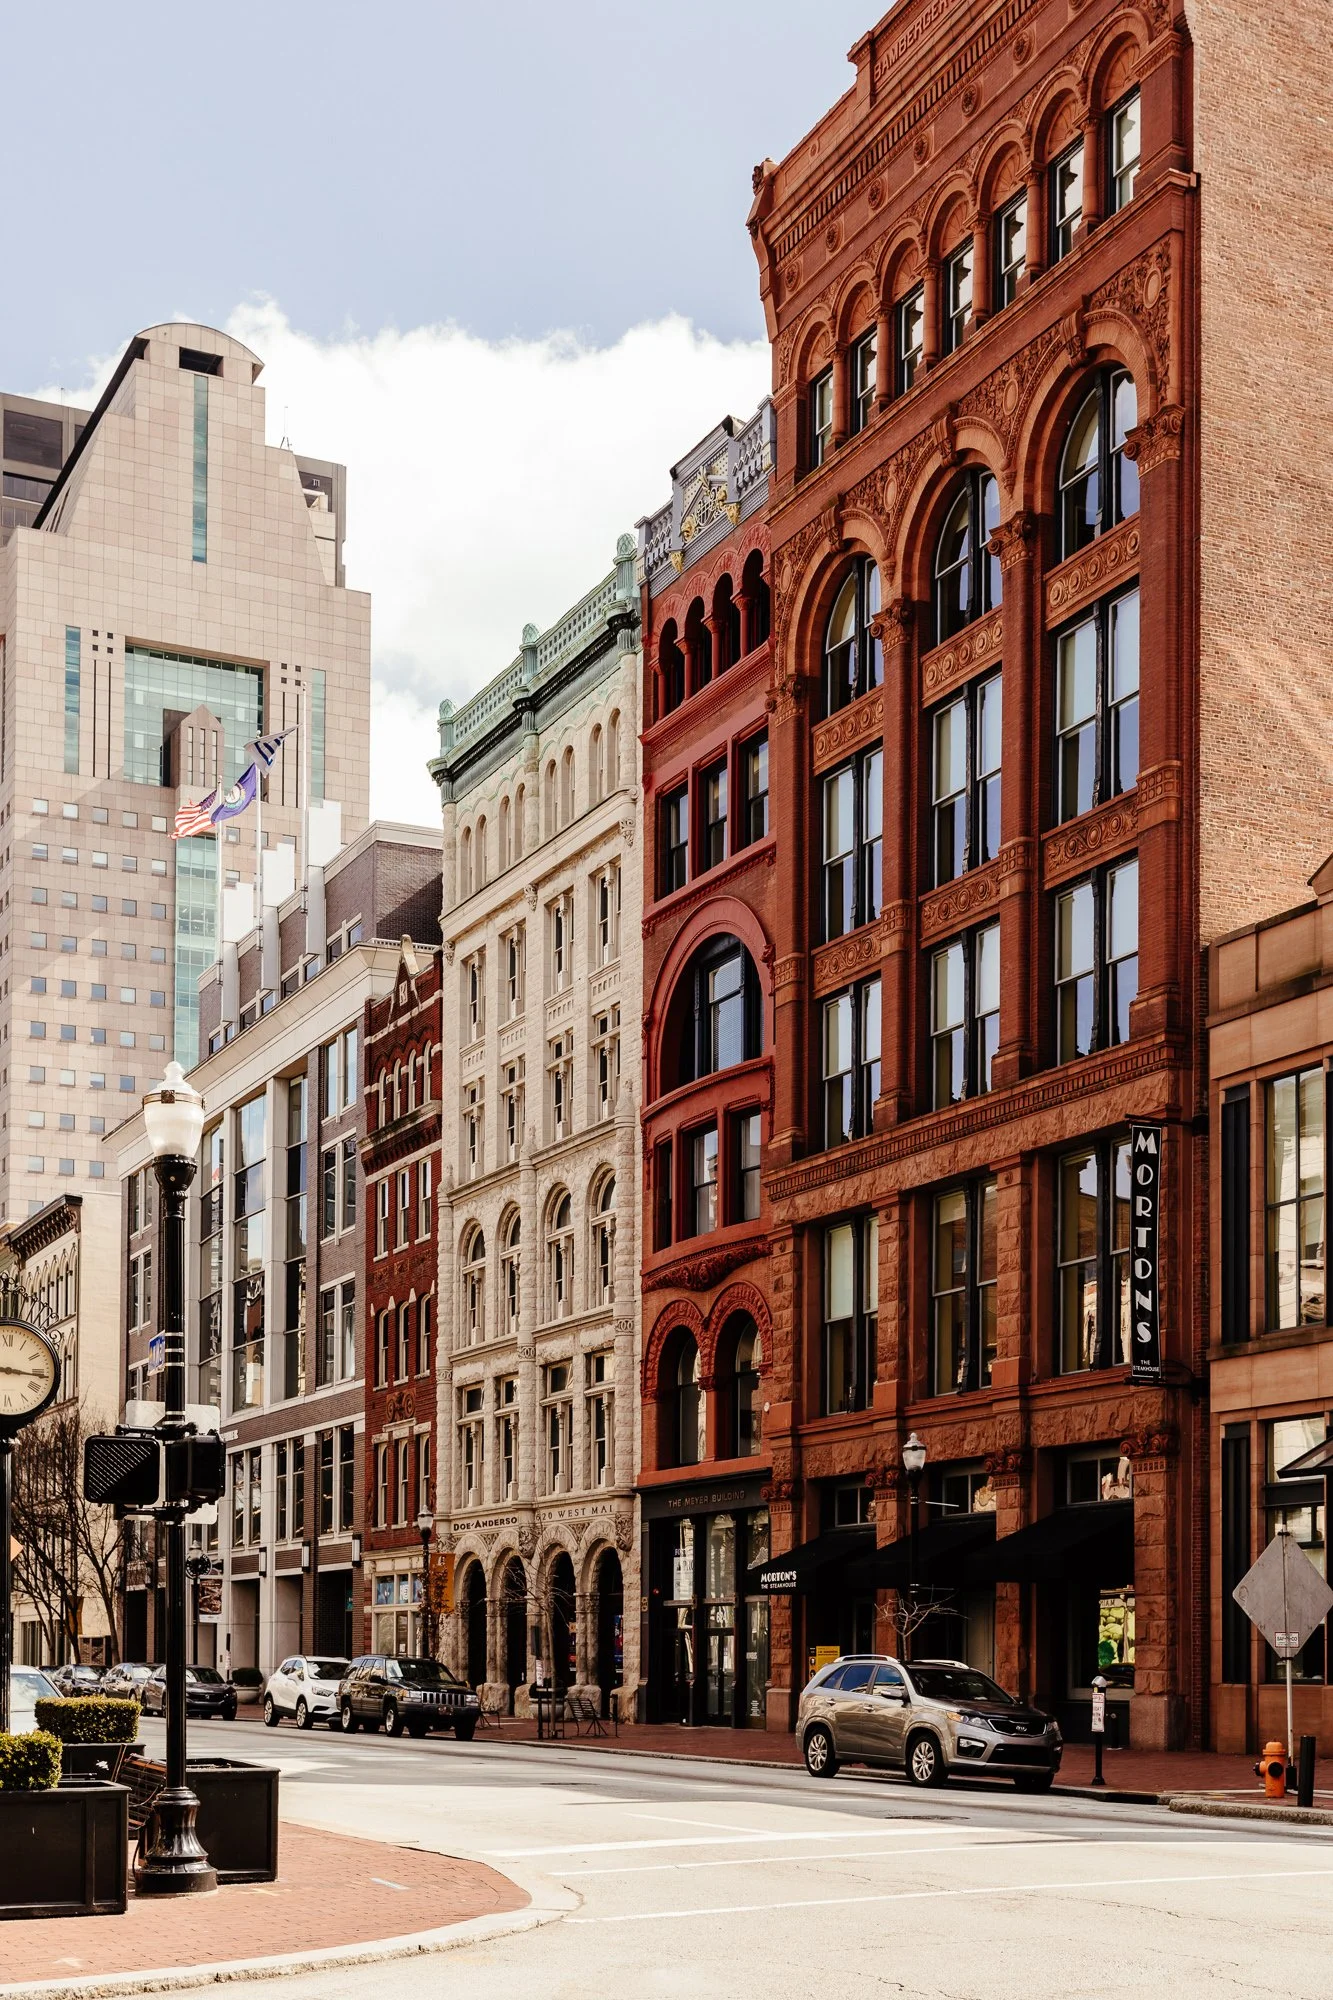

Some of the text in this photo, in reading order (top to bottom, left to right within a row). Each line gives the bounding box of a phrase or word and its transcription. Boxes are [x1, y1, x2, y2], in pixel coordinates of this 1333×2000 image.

[668, 1490, 745, 1508] THE MEYER BUILDING
[535, 1504, 613, 1521] 620 WEST MAI
[453, 1516, 518, 1531] DOE-ANDERSO
[760, 1570, 797, 1583] MORTON'S
[769, 1581, 797, 1589] STEAKHOUSE
